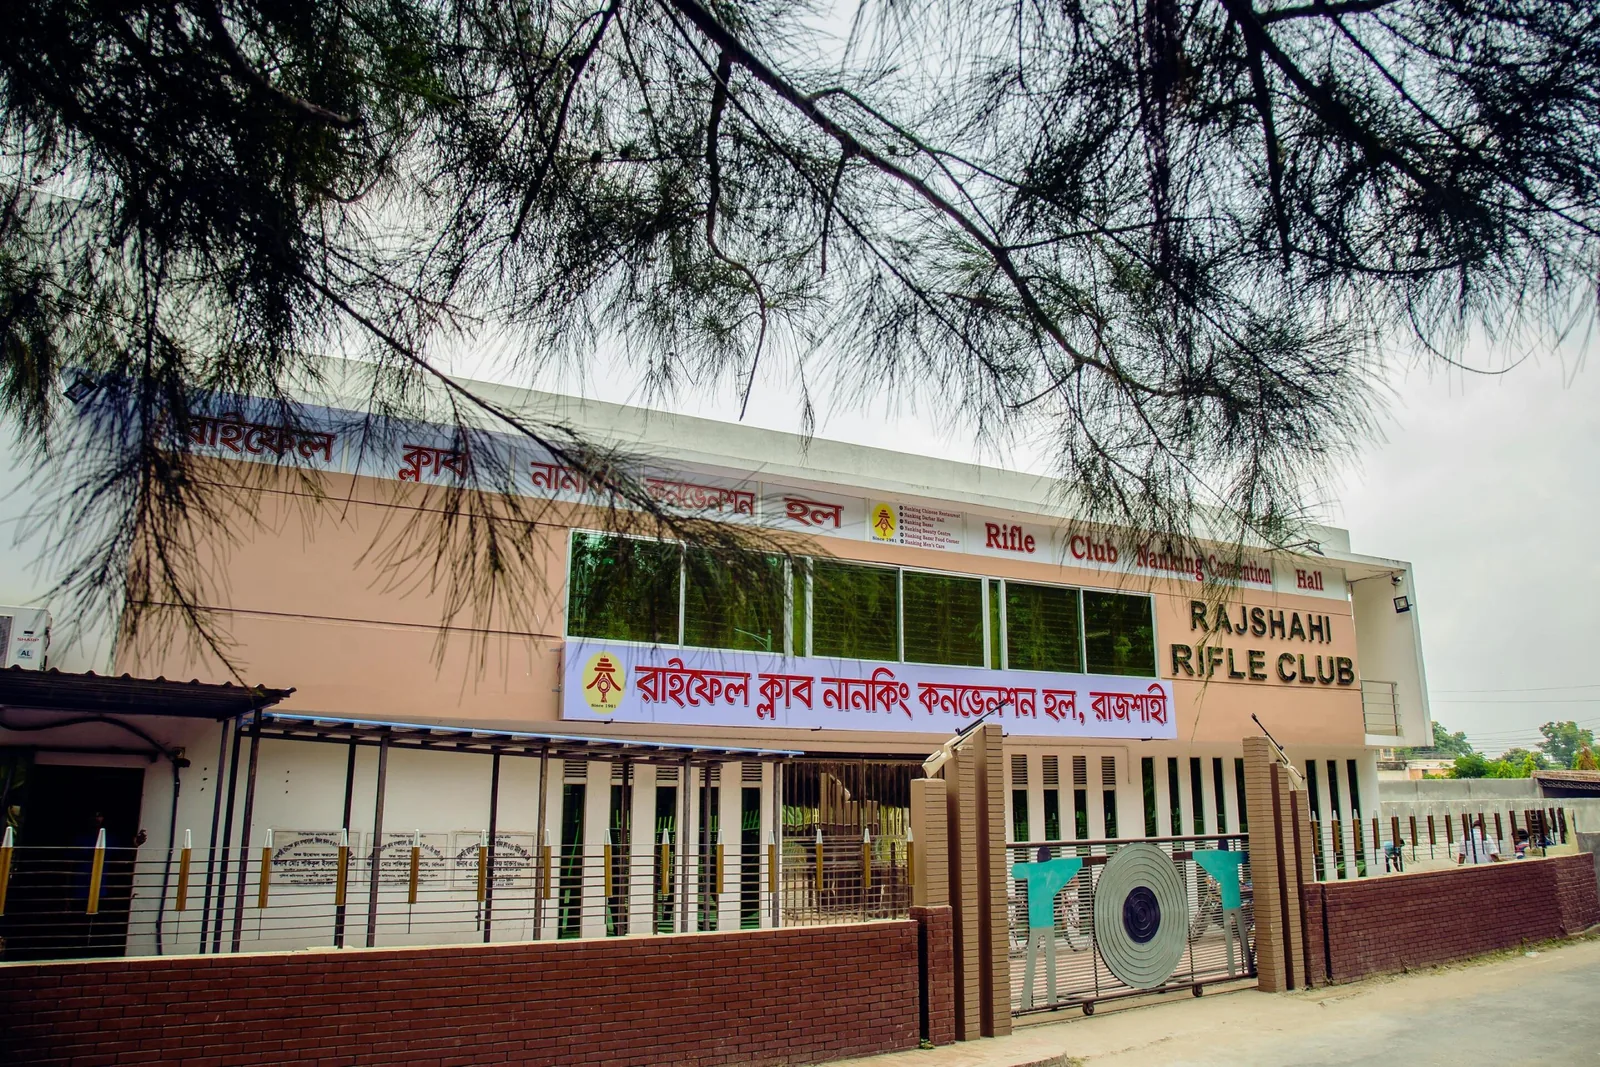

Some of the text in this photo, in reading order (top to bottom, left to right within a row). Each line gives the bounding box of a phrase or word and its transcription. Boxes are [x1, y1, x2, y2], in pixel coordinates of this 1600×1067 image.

[398, 444, 469, 482] ক্লাব
[646, 478, 755, 516] কনভেনশন
[784, 497, 844, 528] হল
[904, 505, 921, 513] Nanking
[922, 528, 937, 536] Beauty
[985, 522, 1036, 553] Rifle
[1070, 535, 1118, 564] Club
[1136, 544, 1204, 582] Nanking
[1296, 569, 1324, 591] Hall
[1190, 600, 1332, 644] RAJSHAHI
[1171, 643, 1355, 685] RIFLE CLUB
[635, 657, 1168, 725] রাইফেল ক্লাব নানকিং কনভেনশন হল, রাজশাহী
[322, 859, 339, 867] ইসলা
